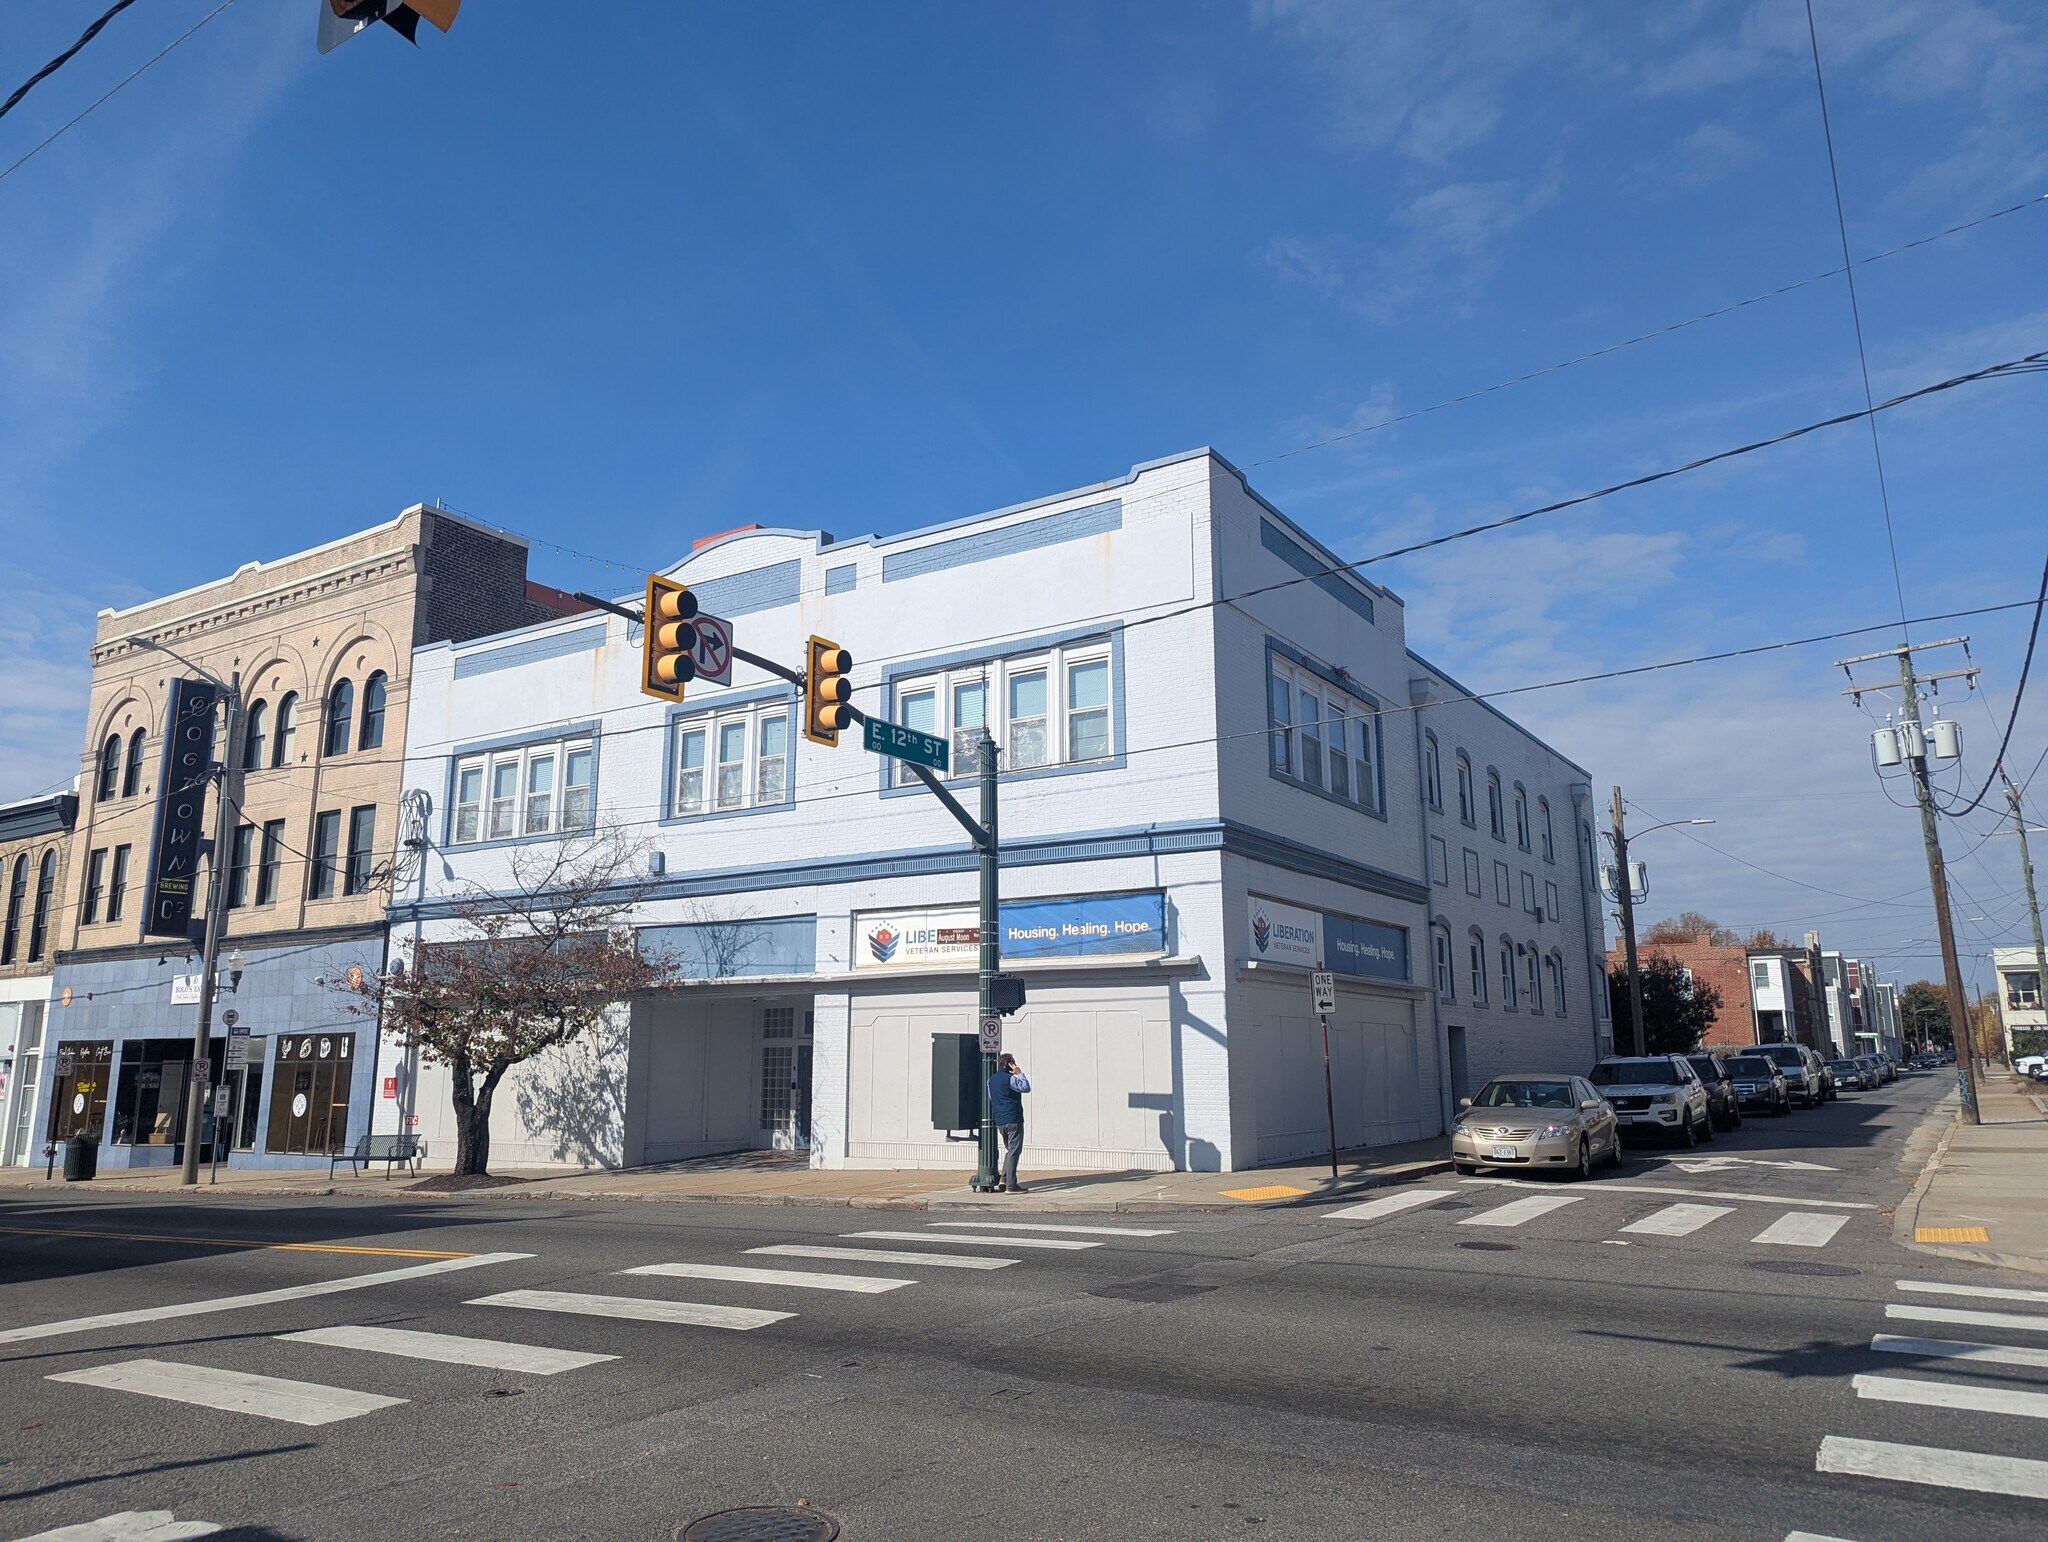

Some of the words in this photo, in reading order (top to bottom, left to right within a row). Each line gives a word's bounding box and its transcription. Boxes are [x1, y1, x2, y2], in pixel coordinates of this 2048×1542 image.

[872, 722, 885, 741] E.
[891, 728, 918, 747] 12th
[923, 738, 942, 756] ST
[871, 741, 882, 751] 00
[159, 881, 189, 890] BREWING
[1008, 926, 1059, 940] Housing.
[1062, 922, 1111, 936] Healing.
[1114, 920, 1152, 934] Hope.
[1272, 923, 1315, 945] LIBERATION
[938, 933, 956, 943] August
[956, 933, 970, 941] Moon
[906, 946, 939, 955] VETERAN
[941, 945, 979, 953] SERVICES
[1273, 941, 1292, 951] VETERAN
[1292, 944, 1311, 955] SERVICES
[1336, 938, 1360, 956] Housing.
[1360, 942, 1381, 960] Healing.
[1381, 946, 1396, 961] Hope.
[1315, 974, 1332, 985] ONE
[1315, 987, 1333, 997] WAY
[405, 1116, 418, 1125] FDC
